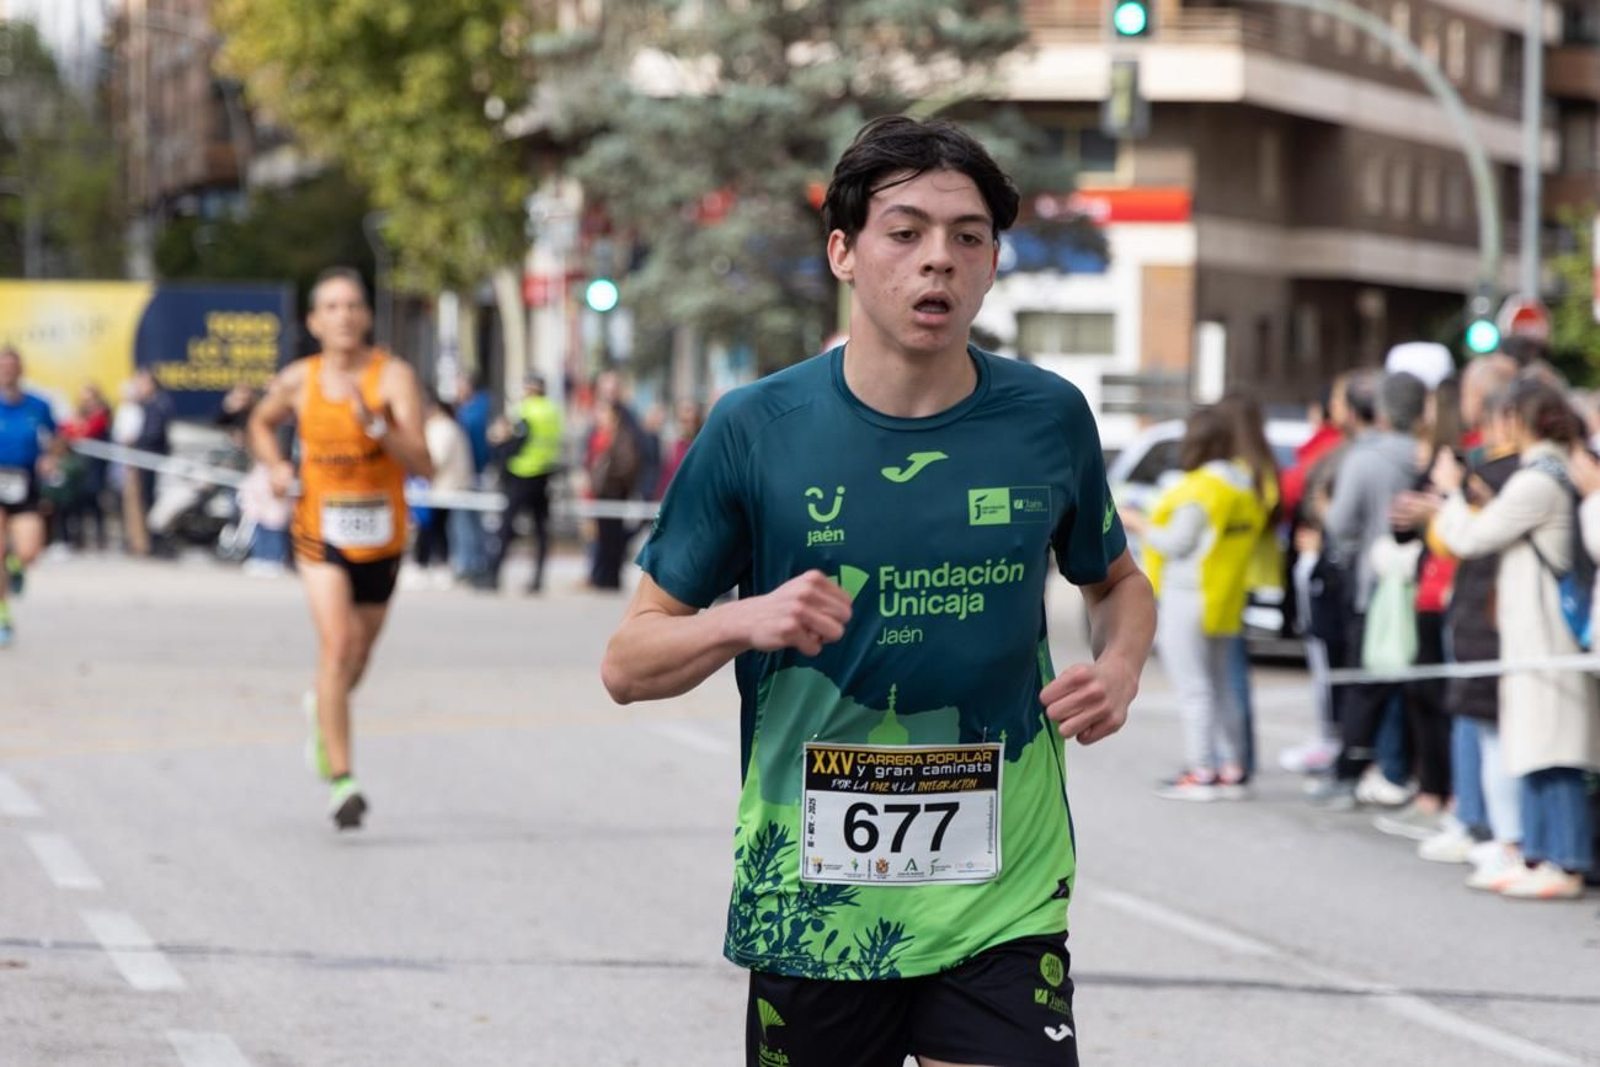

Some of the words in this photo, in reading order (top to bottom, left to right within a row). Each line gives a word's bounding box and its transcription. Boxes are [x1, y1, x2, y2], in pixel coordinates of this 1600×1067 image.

[807, 525, 845, 547] jaén
[879, 558, 1025, 590] Fundación
[879, 587, 985, 620] Unicaja
[876, 625, 923, 645] Jaén
[811, 750, 854, 776] XXV
[857, 752, 924, 766] CARRERA
[926, 751, 993, 764] POPULAR
[856, 765, 866, 777] y
[875, 765, 914, 779] gran
[922, 762, 992, 776] caminata
[831, 778, 852, 789] POR
[853, 779, 869, 791] LA
[900, 781, 916, 793] LA
[843, 801, 960, 853] 677
